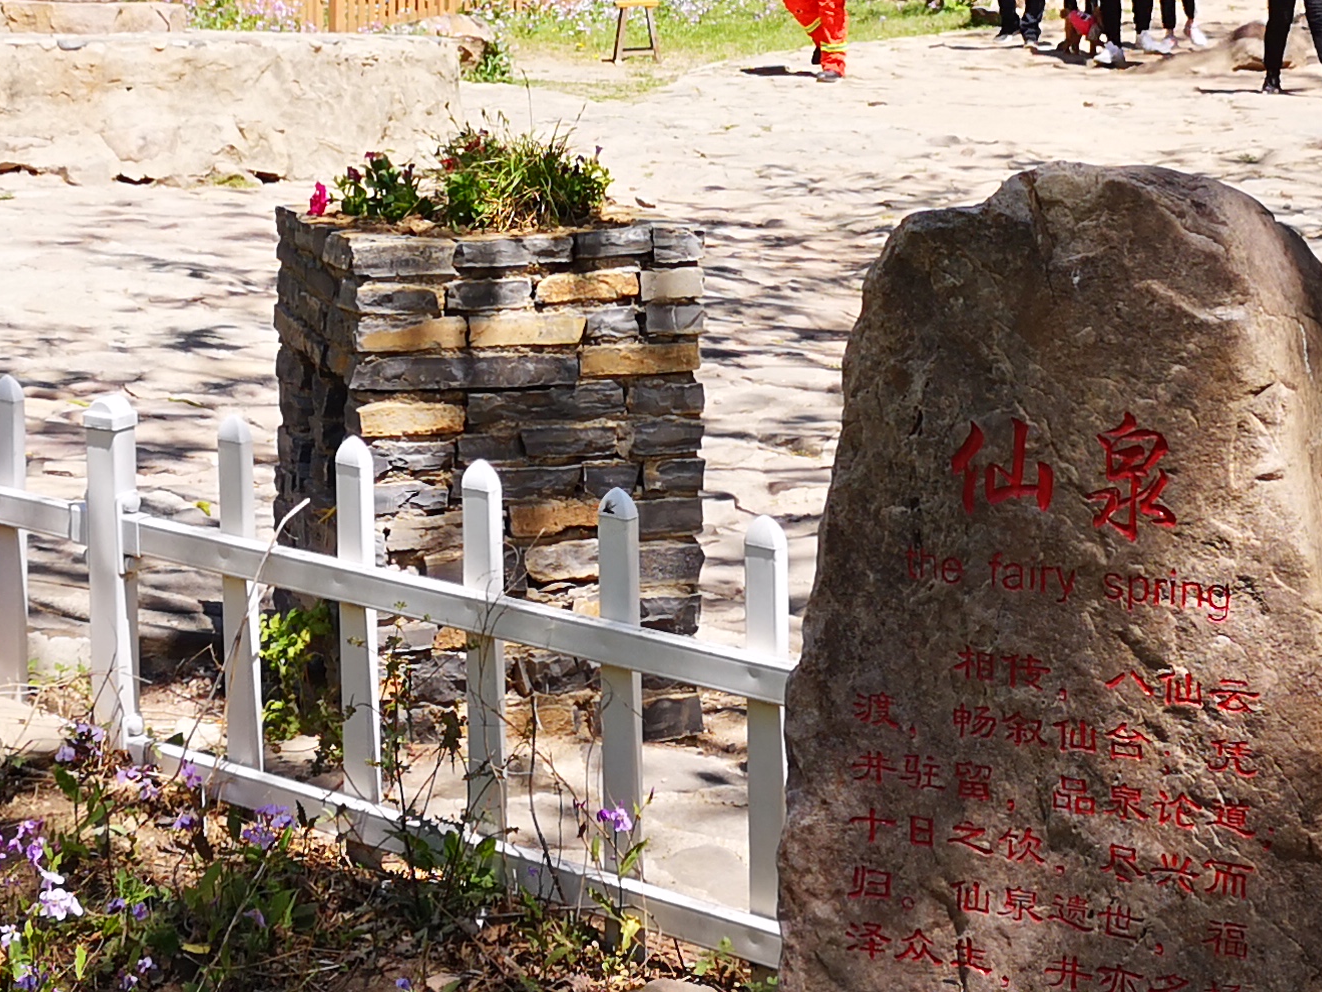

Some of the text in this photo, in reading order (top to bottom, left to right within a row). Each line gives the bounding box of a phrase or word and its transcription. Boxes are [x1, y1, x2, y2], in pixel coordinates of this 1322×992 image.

[951, 411, 1177, 542] 仙泉
[905, 545, 1233, 623] the fairy spring
